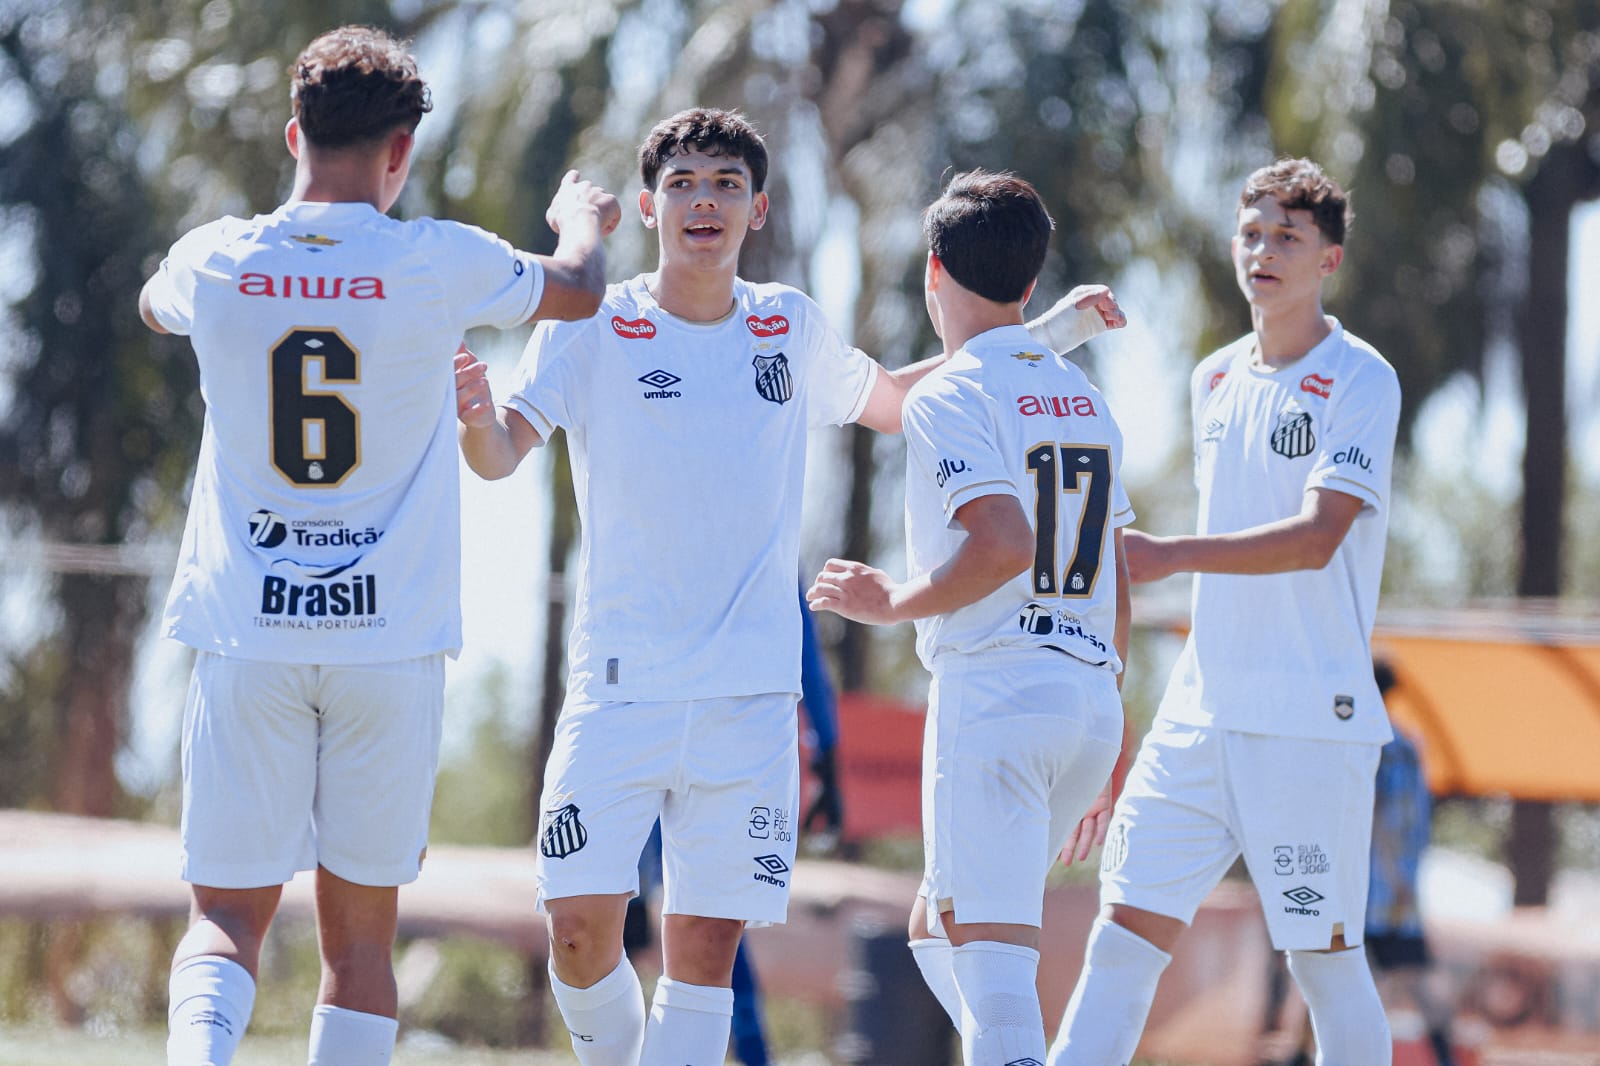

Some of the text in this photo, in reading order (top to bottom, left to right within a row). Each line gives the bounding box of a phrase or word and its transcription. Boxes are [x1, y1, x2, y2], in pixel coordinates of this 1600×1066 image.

[239, 272, 387, 300] aiwa
[613, 320, 654, 336] Canção
[644, 390, 681, 399] umbro
[267, 325, 362, 489] 6
[292, 519, 344, 528] consórcio
[1025, 441, 1113, 598] 17
[261, 574, 376, 617] Brasil
[253, 617, 387, 630] TERMINAL PORTUÁRIO
[1298, 844, 1321, 856] SUA
[1298, 853, 1327, 865] FOTO
[754, 872, 786, 888] umbro
[1284, 905, 1320, 917] umbro
